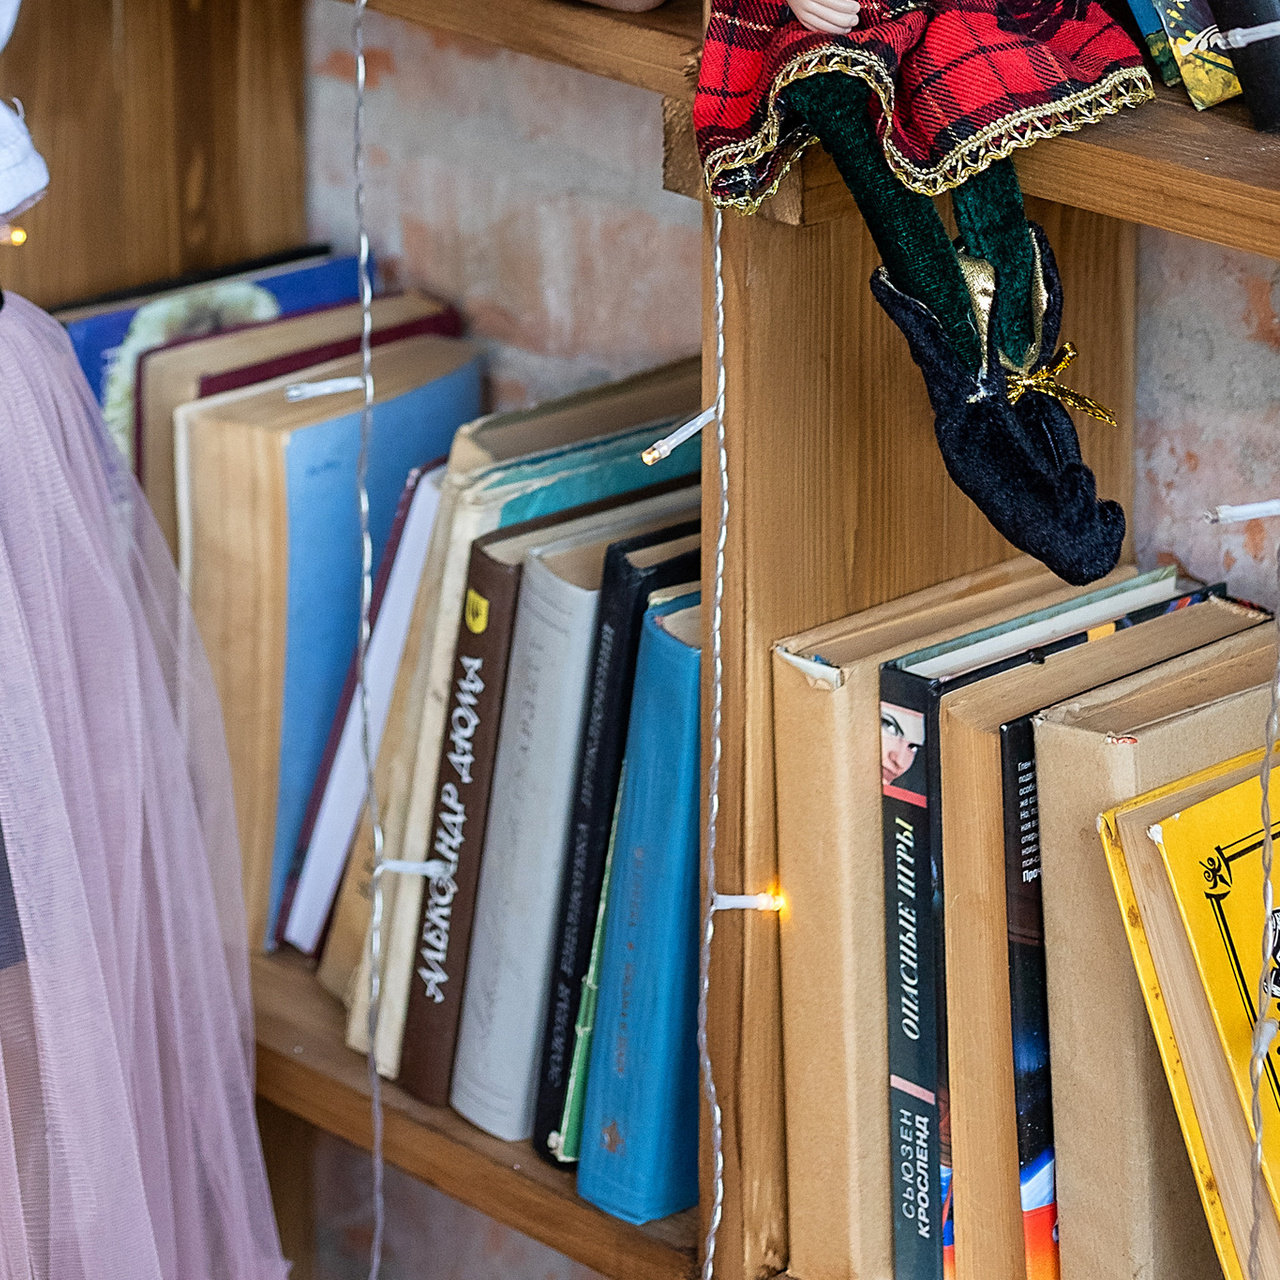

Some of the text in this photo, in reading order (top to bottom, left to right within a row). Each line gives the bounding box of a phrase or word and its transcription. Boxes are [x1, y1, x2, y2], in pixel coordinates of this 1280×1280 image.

[446, 654, 486, 784] ДЮМА
[894, 816, 921, 1042] ОПАСНЫЕ ИГРЫ
[901, 1107, 915, 1221] СЬЮЗЕН
[916, 1114, 932, 1240] КРОСЛЕНД
